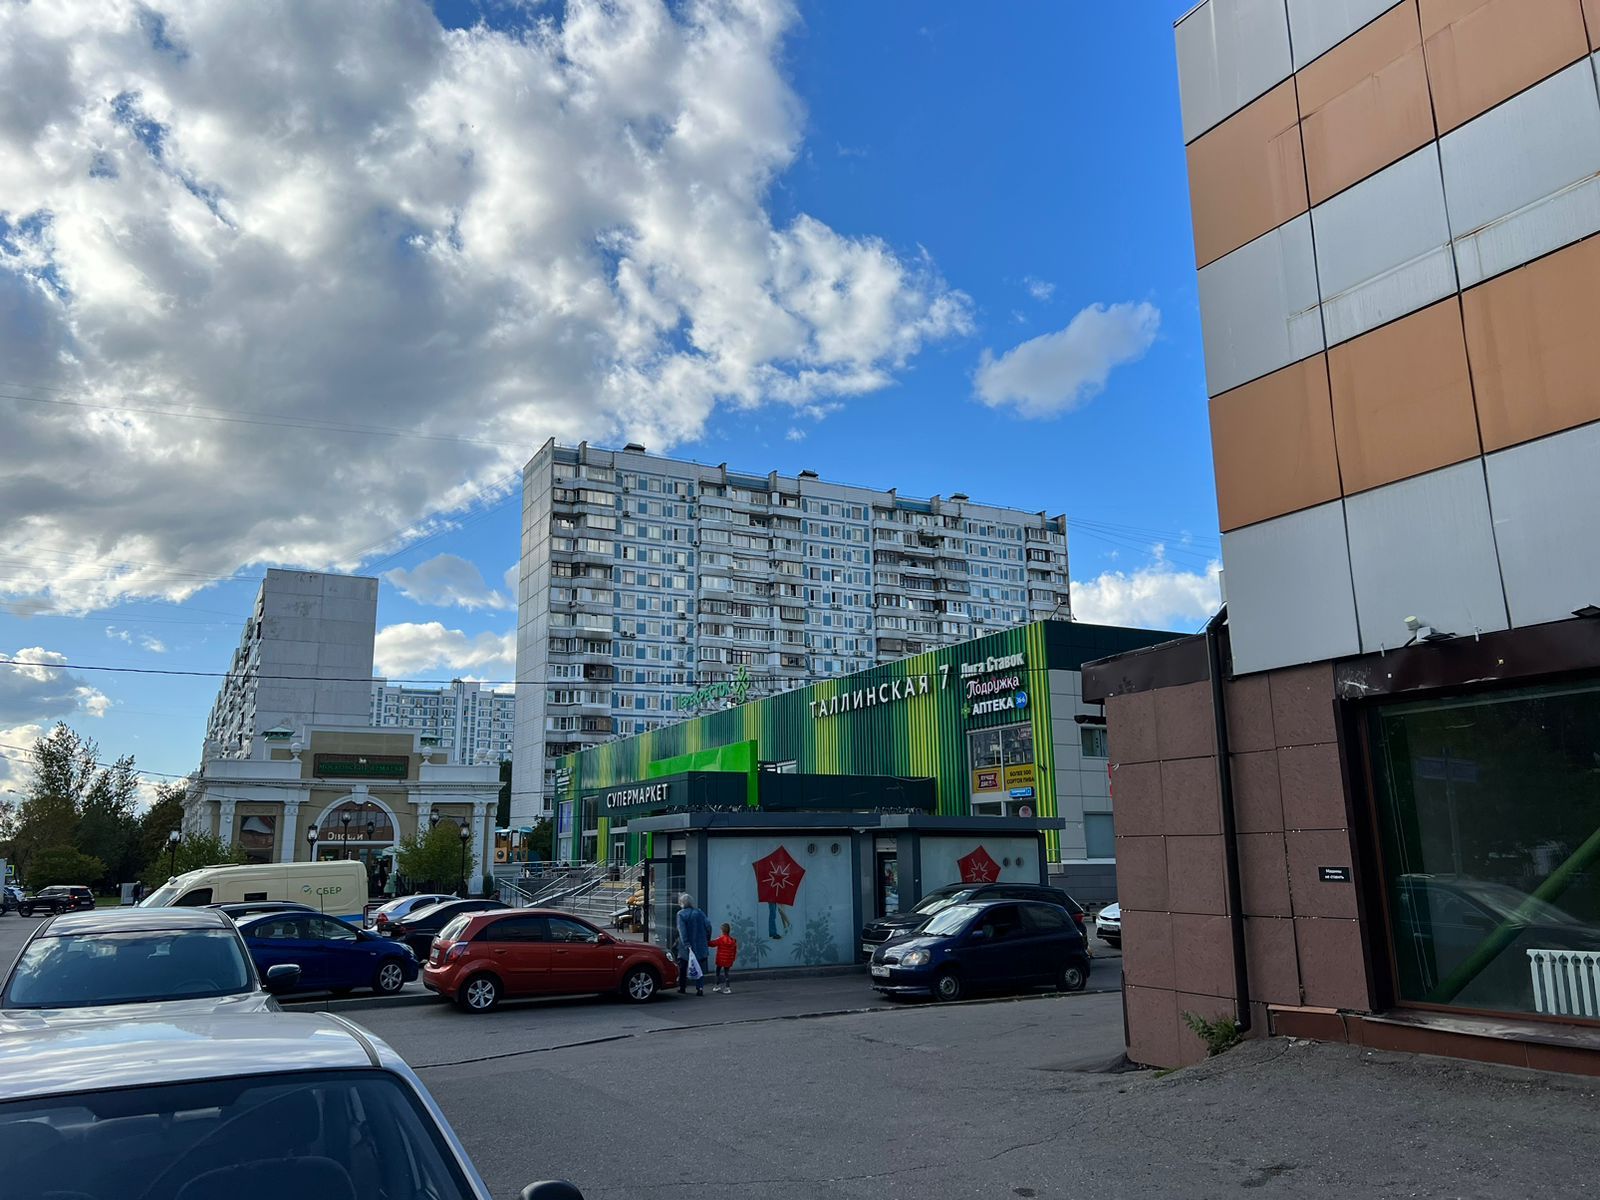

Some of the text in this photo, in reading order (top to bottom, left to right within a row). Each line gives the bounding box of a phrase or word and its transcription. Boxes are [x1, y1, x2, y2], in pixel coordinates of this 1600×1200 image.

[986, 652, 1025, 672] Ставок
[809, 664, 949, 719] ТАЛЛИНСКАЯ 7
[966, 676, 1020, 699] Подружка
[972, 696, 1015, 716] АПТЕКА
[606, 783, 668, 808] СУПЕРМАРКЕТ
[315, 886, 342, 896] СБЕР
